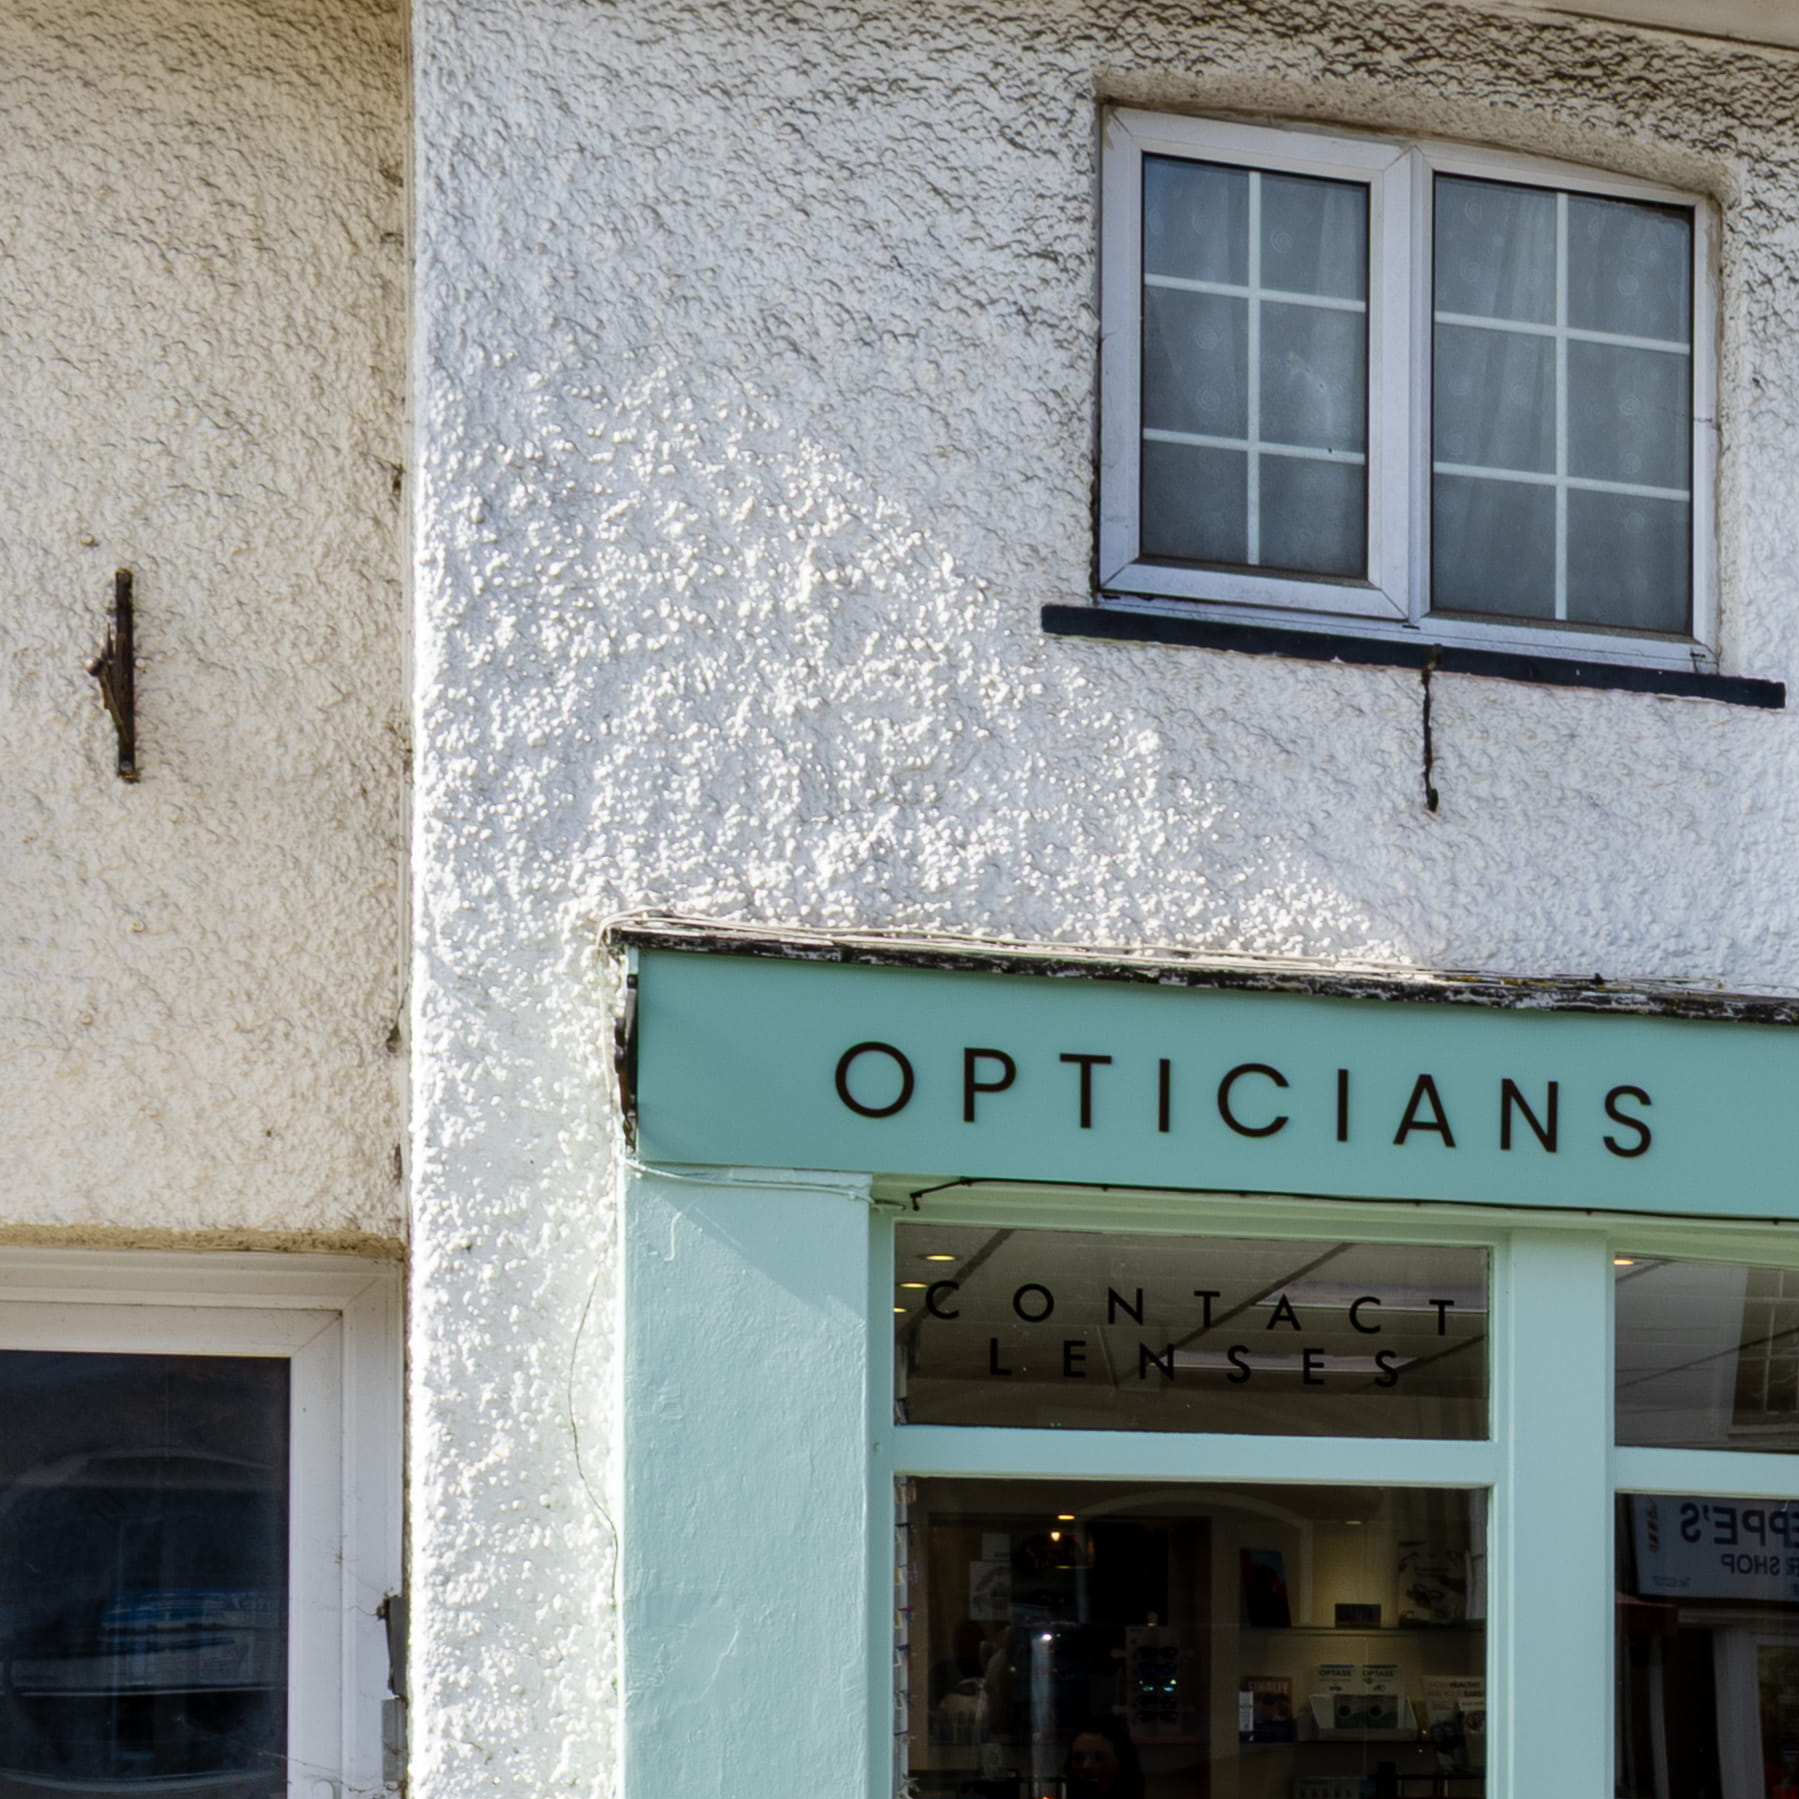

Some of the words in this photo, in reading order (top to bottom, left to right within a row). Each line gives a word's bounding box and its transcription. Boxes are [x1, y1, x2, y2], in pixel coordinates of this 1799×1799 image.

[834, 1040, 1652, 1159] OPTICIANS
[924, 1280, 1456, 1336] CONTACT
[990, 1337, 1401, 1388] LENSES
